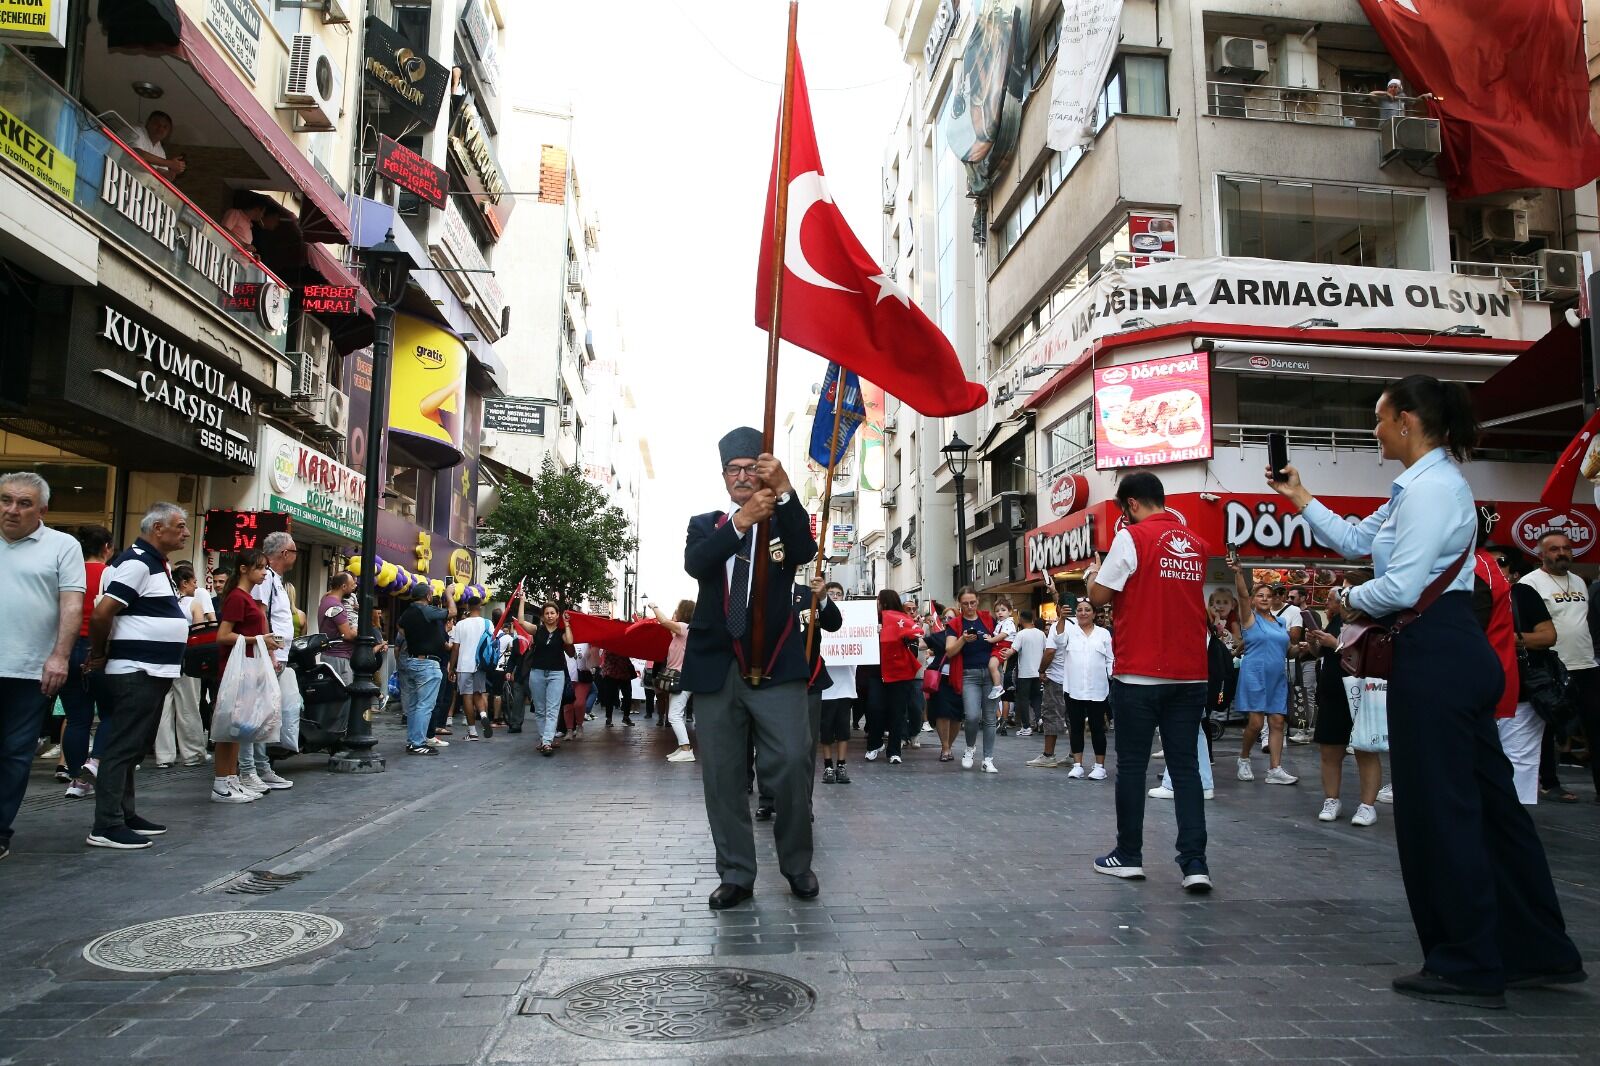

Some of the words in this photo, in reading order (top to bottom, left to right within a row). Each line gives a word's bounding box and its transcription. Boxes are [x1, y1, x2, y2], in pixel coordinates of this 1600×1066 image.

[0, 11, 46, 26] ÇENEKLERİ
[235, 25, 257, 60] ENGİN
[101, 154, 177, 252] BERBER
[187, 225, 239, 298] MURAT
[305, 286, 354, 299] BERBER
[1209, 276, 1394, 308] ARMAĞAN
[1405, 284, 1511, 318] OLSUN
[306, 299, 351, 311] MURAT
[103, 305, 252, 416] KUYUMCULAR
[416, 345, 443, 362] gratis
[1131, 356, 1199, 380] Dönerevi
[140, 370, 224, 431] ÇARŞISI
[200, 430, 223, 452] SES
[1097, 455, 1131, 468] PİLAV
[1134, 449, 1167, 464] ÜSTÜ
[1170, 445, 1209, 460] MENÜ
[1028, 513, 1092, 574] Dönerevi
[1160, 569, 1203, 582] MERKEZLE
[1552, 591, 1586, 603] BOSS
